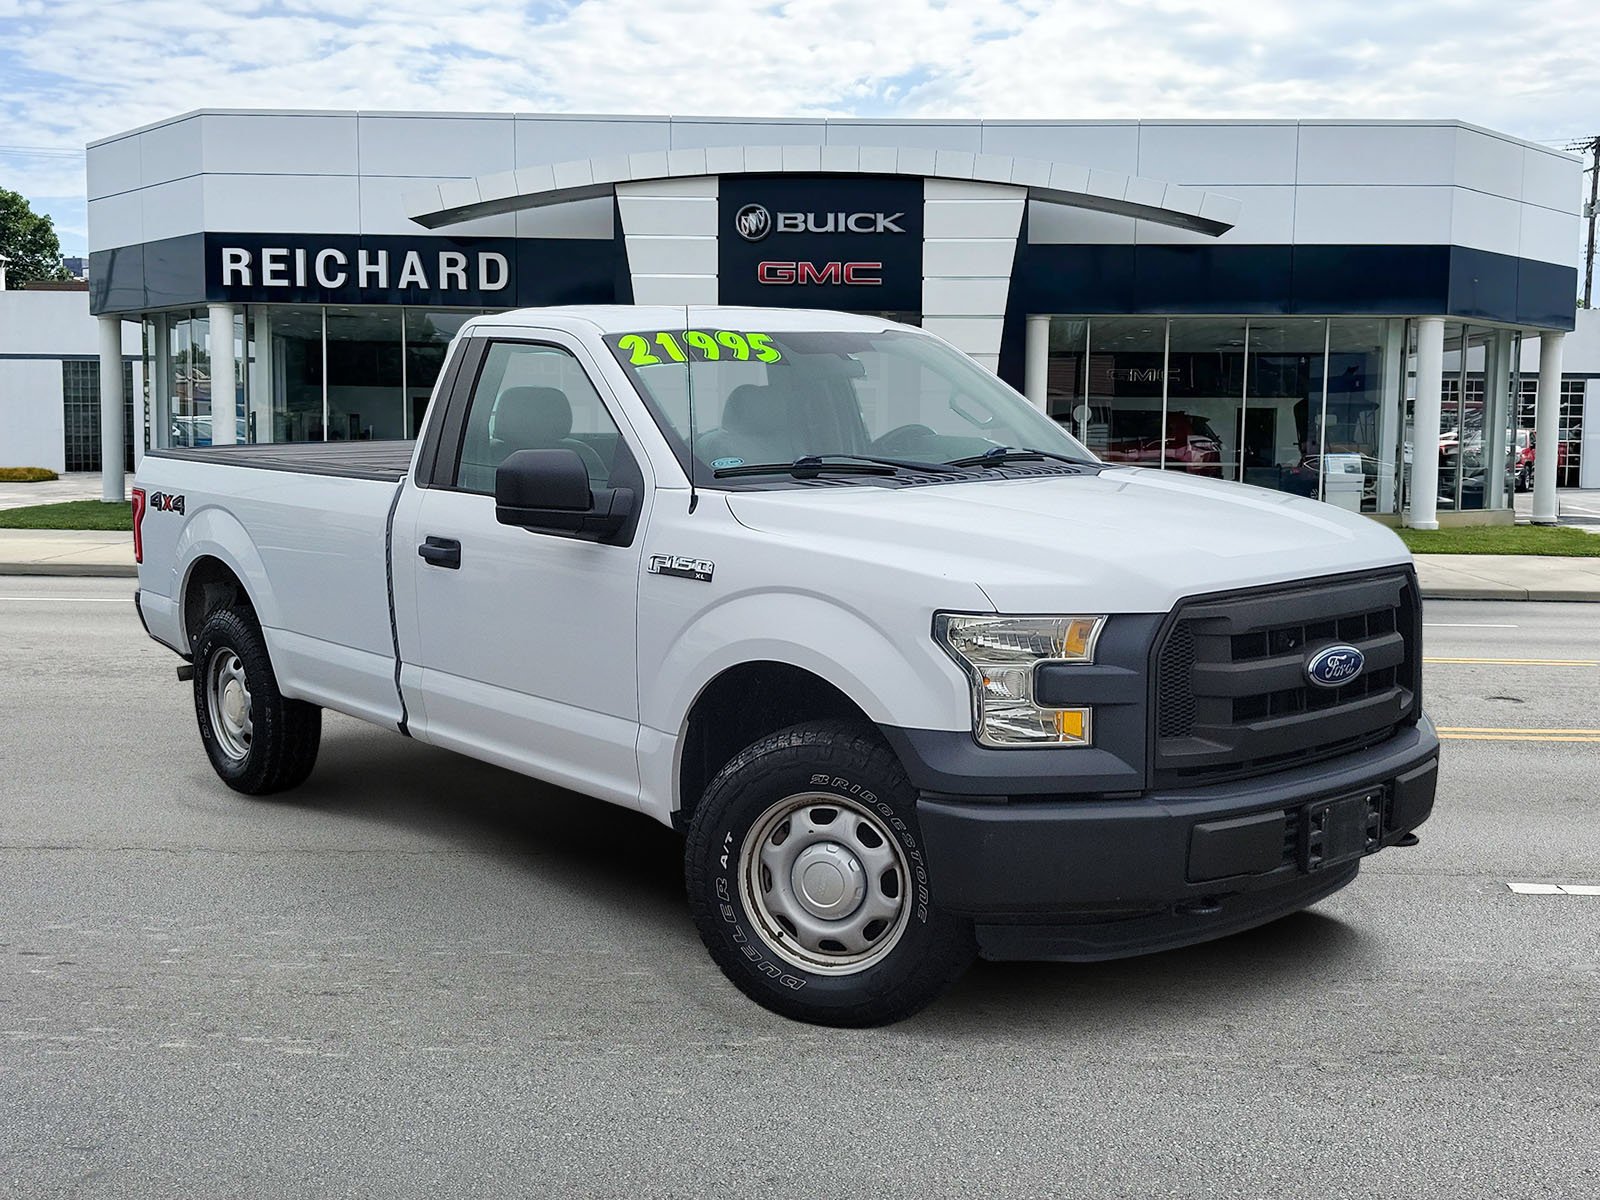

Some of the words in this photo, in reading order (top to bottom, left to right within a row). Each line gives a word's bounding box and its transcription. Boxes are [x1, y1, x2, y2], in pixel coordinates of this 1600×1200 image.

[776, 212, 906, 233] BUICK
[221, 247, 510, 291] REICHARD
[758, 261, 882, 285] GMC
[618, 330, 782, 366] 21995
[694, 572, 706, 580] XL
[1325, 654, 1355, 679] Ford
[720, 831, 735, 869] A/T
[810, 774, 928, 923] BRIDGESTONE
[716, 877, 807, 991] DUELER
